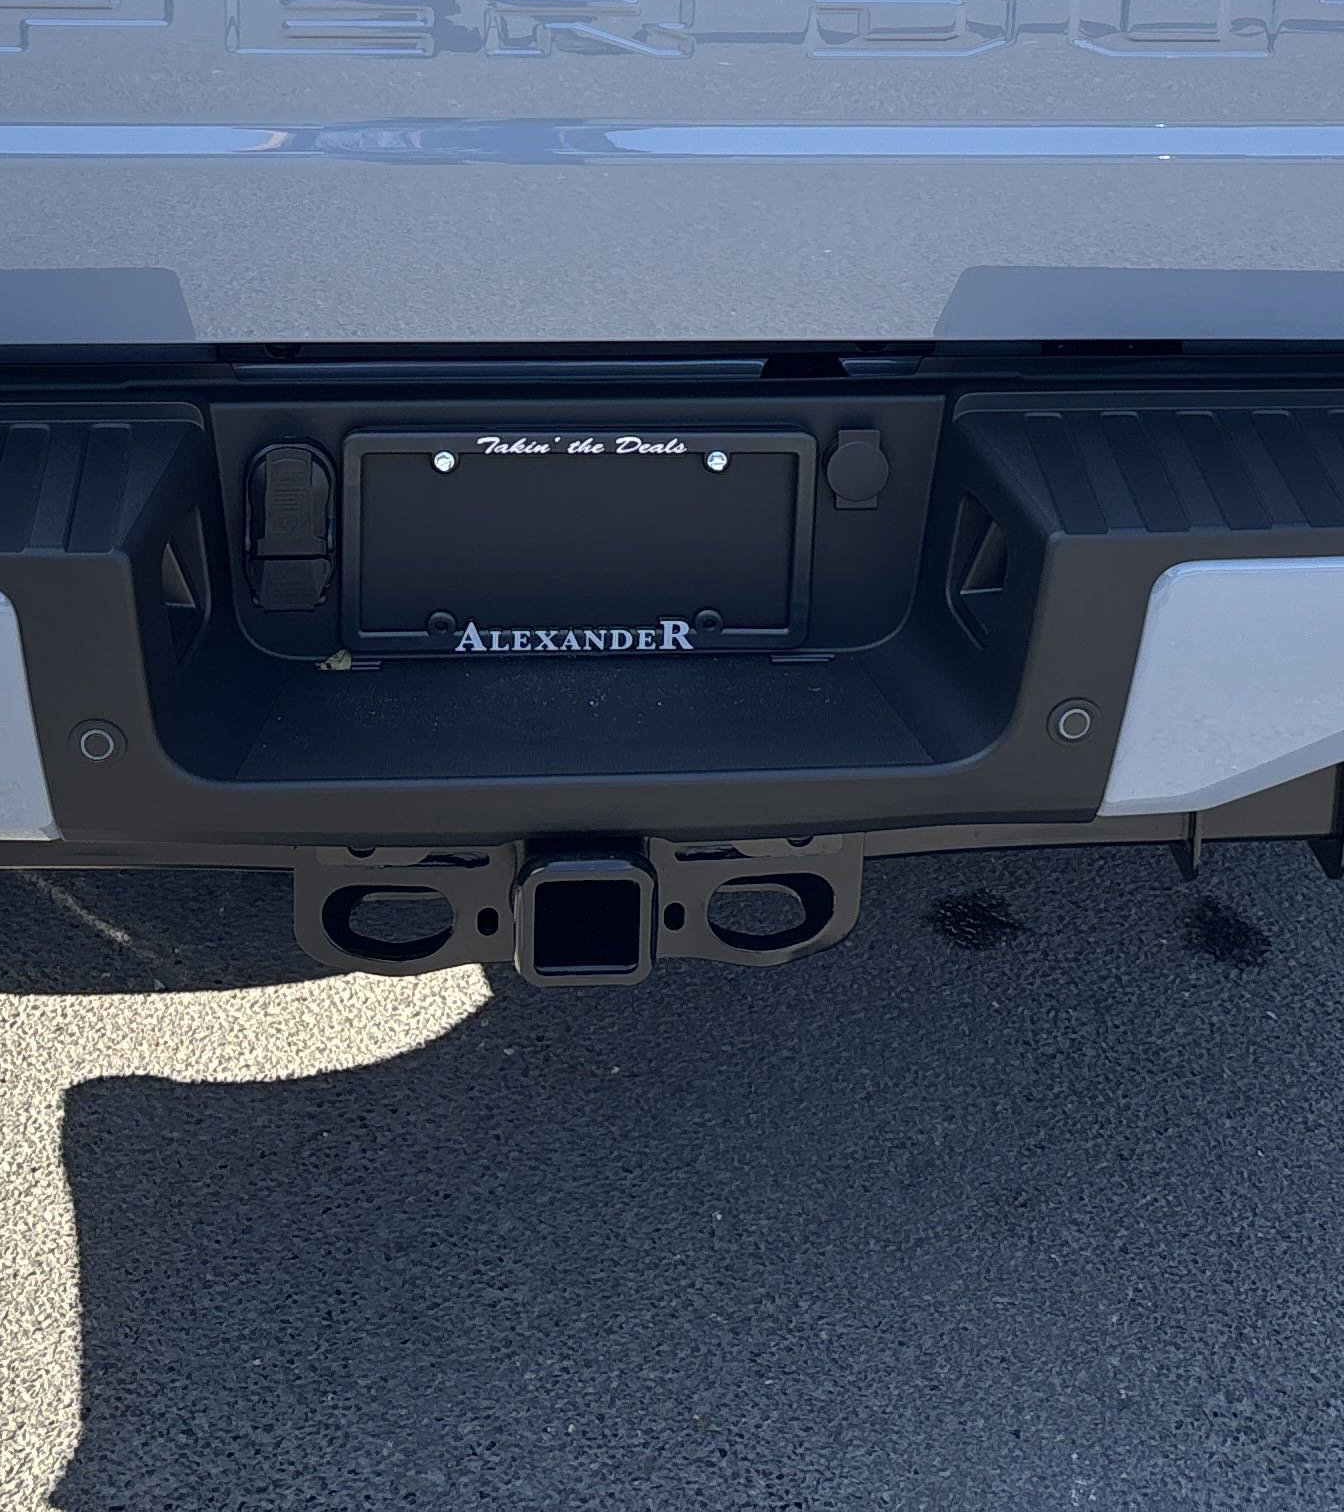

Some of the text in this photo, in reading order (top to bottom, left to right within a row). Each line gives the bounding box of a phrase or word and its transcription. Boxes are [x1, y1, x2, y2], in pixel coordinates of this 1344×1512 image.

[477, 436, 687, 455] Takin' the Deals
